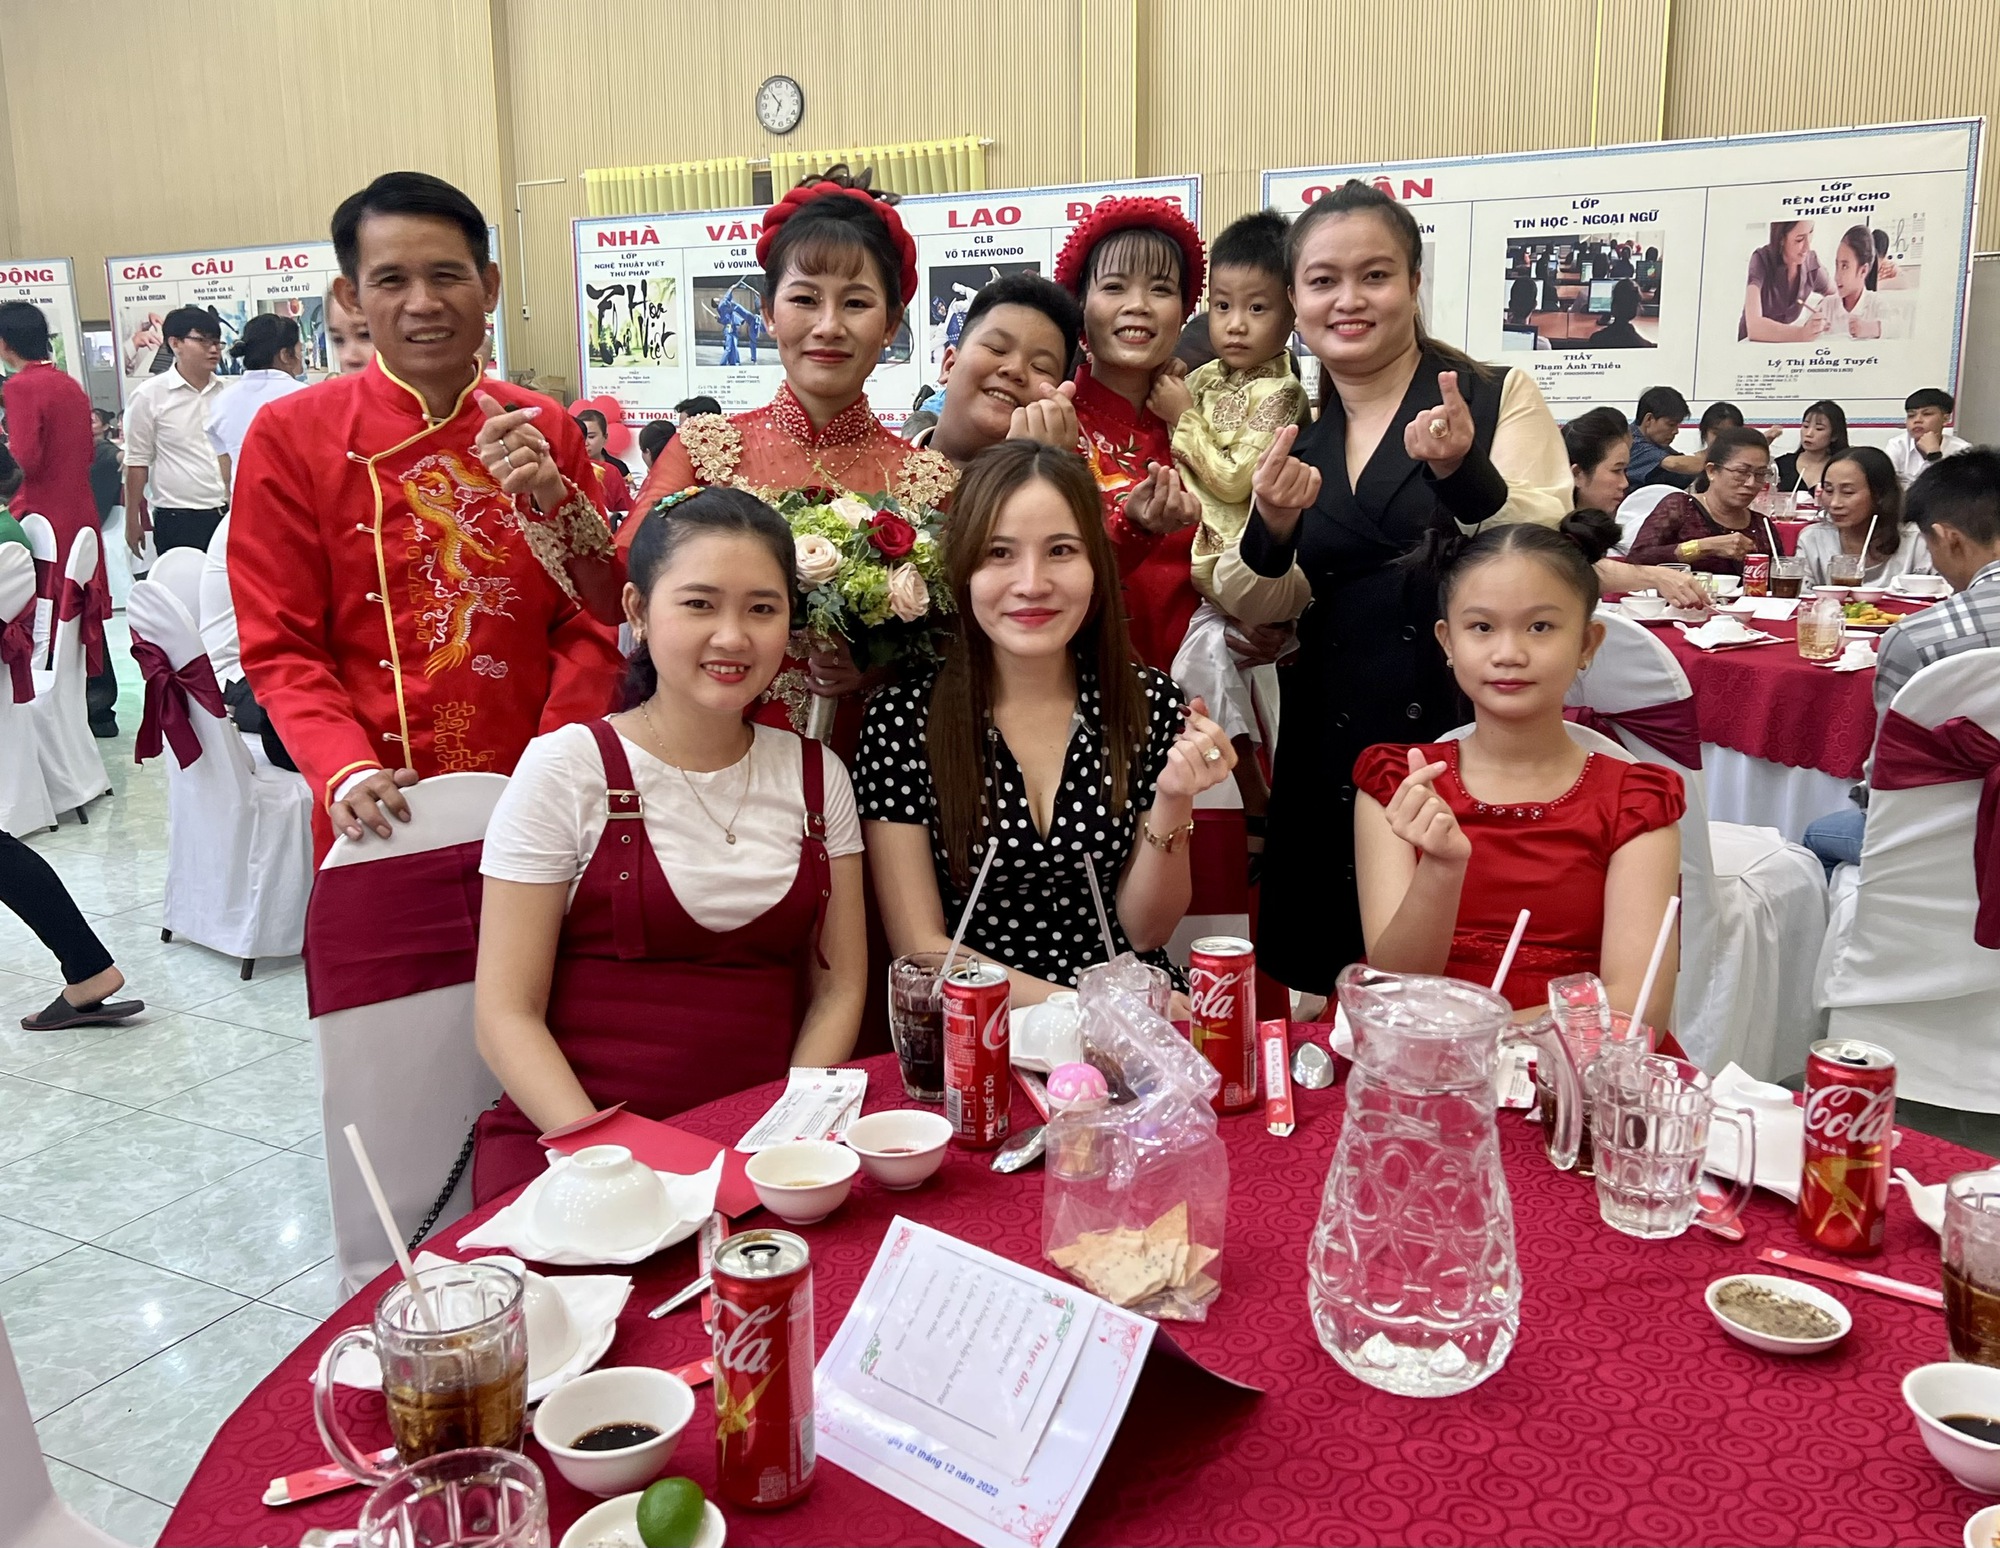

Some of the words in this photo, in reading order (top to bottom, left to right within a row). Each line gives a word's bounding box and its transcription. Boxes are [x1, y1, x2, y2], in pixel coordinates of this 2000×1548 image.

[1821, 181, 1853, 192] LỚP
[1857, 191, 1890, 201] CHO
[1572, 197, 1600, 210] LỚP
[1794, 204, 1842, 216] THIẾU
[1847, 204, 1875, 214] NHI
[948, 206, 1022, 229] LAO
[1513, 218, 1536, 229] TIN
[1540, 216, 1569, 229] HỌC
[1582, 213, 1625, 226] NGOẠI
[1629, 209, 1660, 223] NGỮ
[597, 225, 660, 247] NHÀ
[974, 235, 994, 244] CLB
[621, 252, 637, 260] LỚP
[730, 248, 747, 257] CLB
[945, 248, 958, 259] VÕ
[961, 246, 1024, 258] TAEKWONDO
[122, 263, 163, 280] CÁC
[191, 258, 234, 276] CÂU
[265, 254, 309, 272] LẠC
[618, 260, 644, 269] THUẬT
[647, 259, 666, 268] VIẾT
[713, 259, 725, 269] VÕ
[727, 260, 761, 269] VOVINA
[628, 268, 650, 277] PHÁP
[1767, 359, 1782, 368] Lý
[1843, 356, 1879, 366] Tuyết
[983, 1074, 995, 1095] TÔI
[982, 1095, 995, 1120] CHẾ
[943, 1461, 956, 1475] 12
